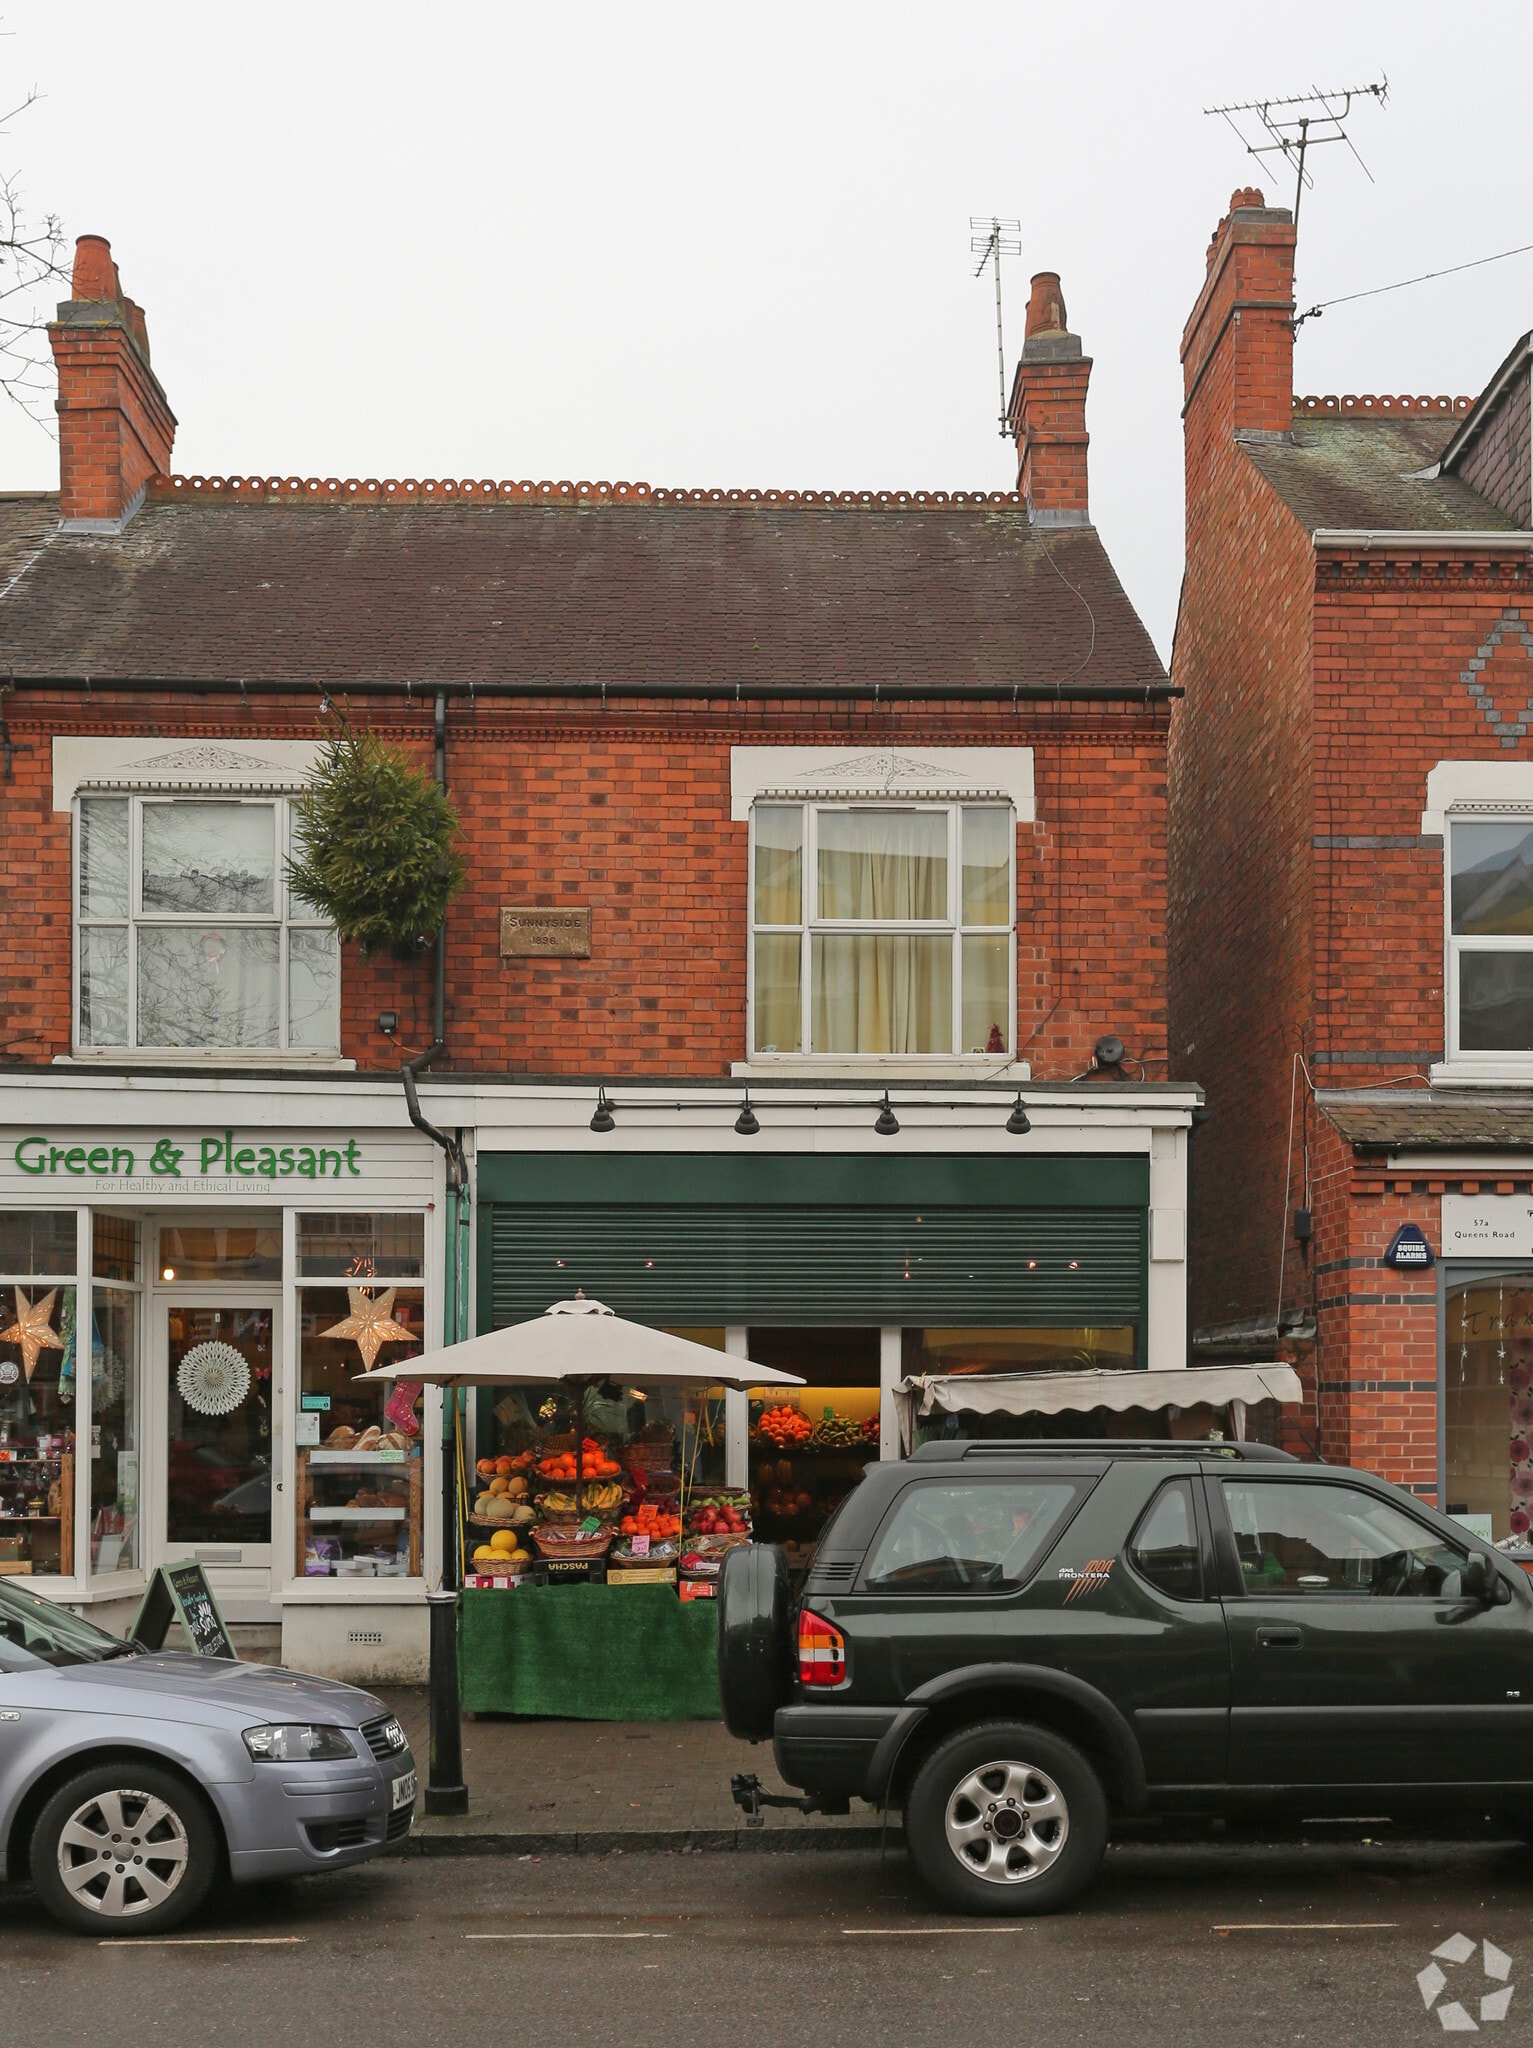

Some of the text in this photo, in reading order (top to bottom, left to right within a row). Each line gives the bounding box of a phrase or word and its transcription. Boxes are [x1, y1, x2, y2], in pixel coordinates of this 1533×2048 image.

[509, 917, 581, 928] SUNNYSIDE
[15, 1130, 362, 1179] Green & Pleasant
[95, 1179, 271, 1193] For Healthy and Ethical Living
[1473, 1219, 1489, 1227] 57a
[1454, 1231, 1515, 1239] Queens Road
[548, 1562, 589, 1570] PASCHA
